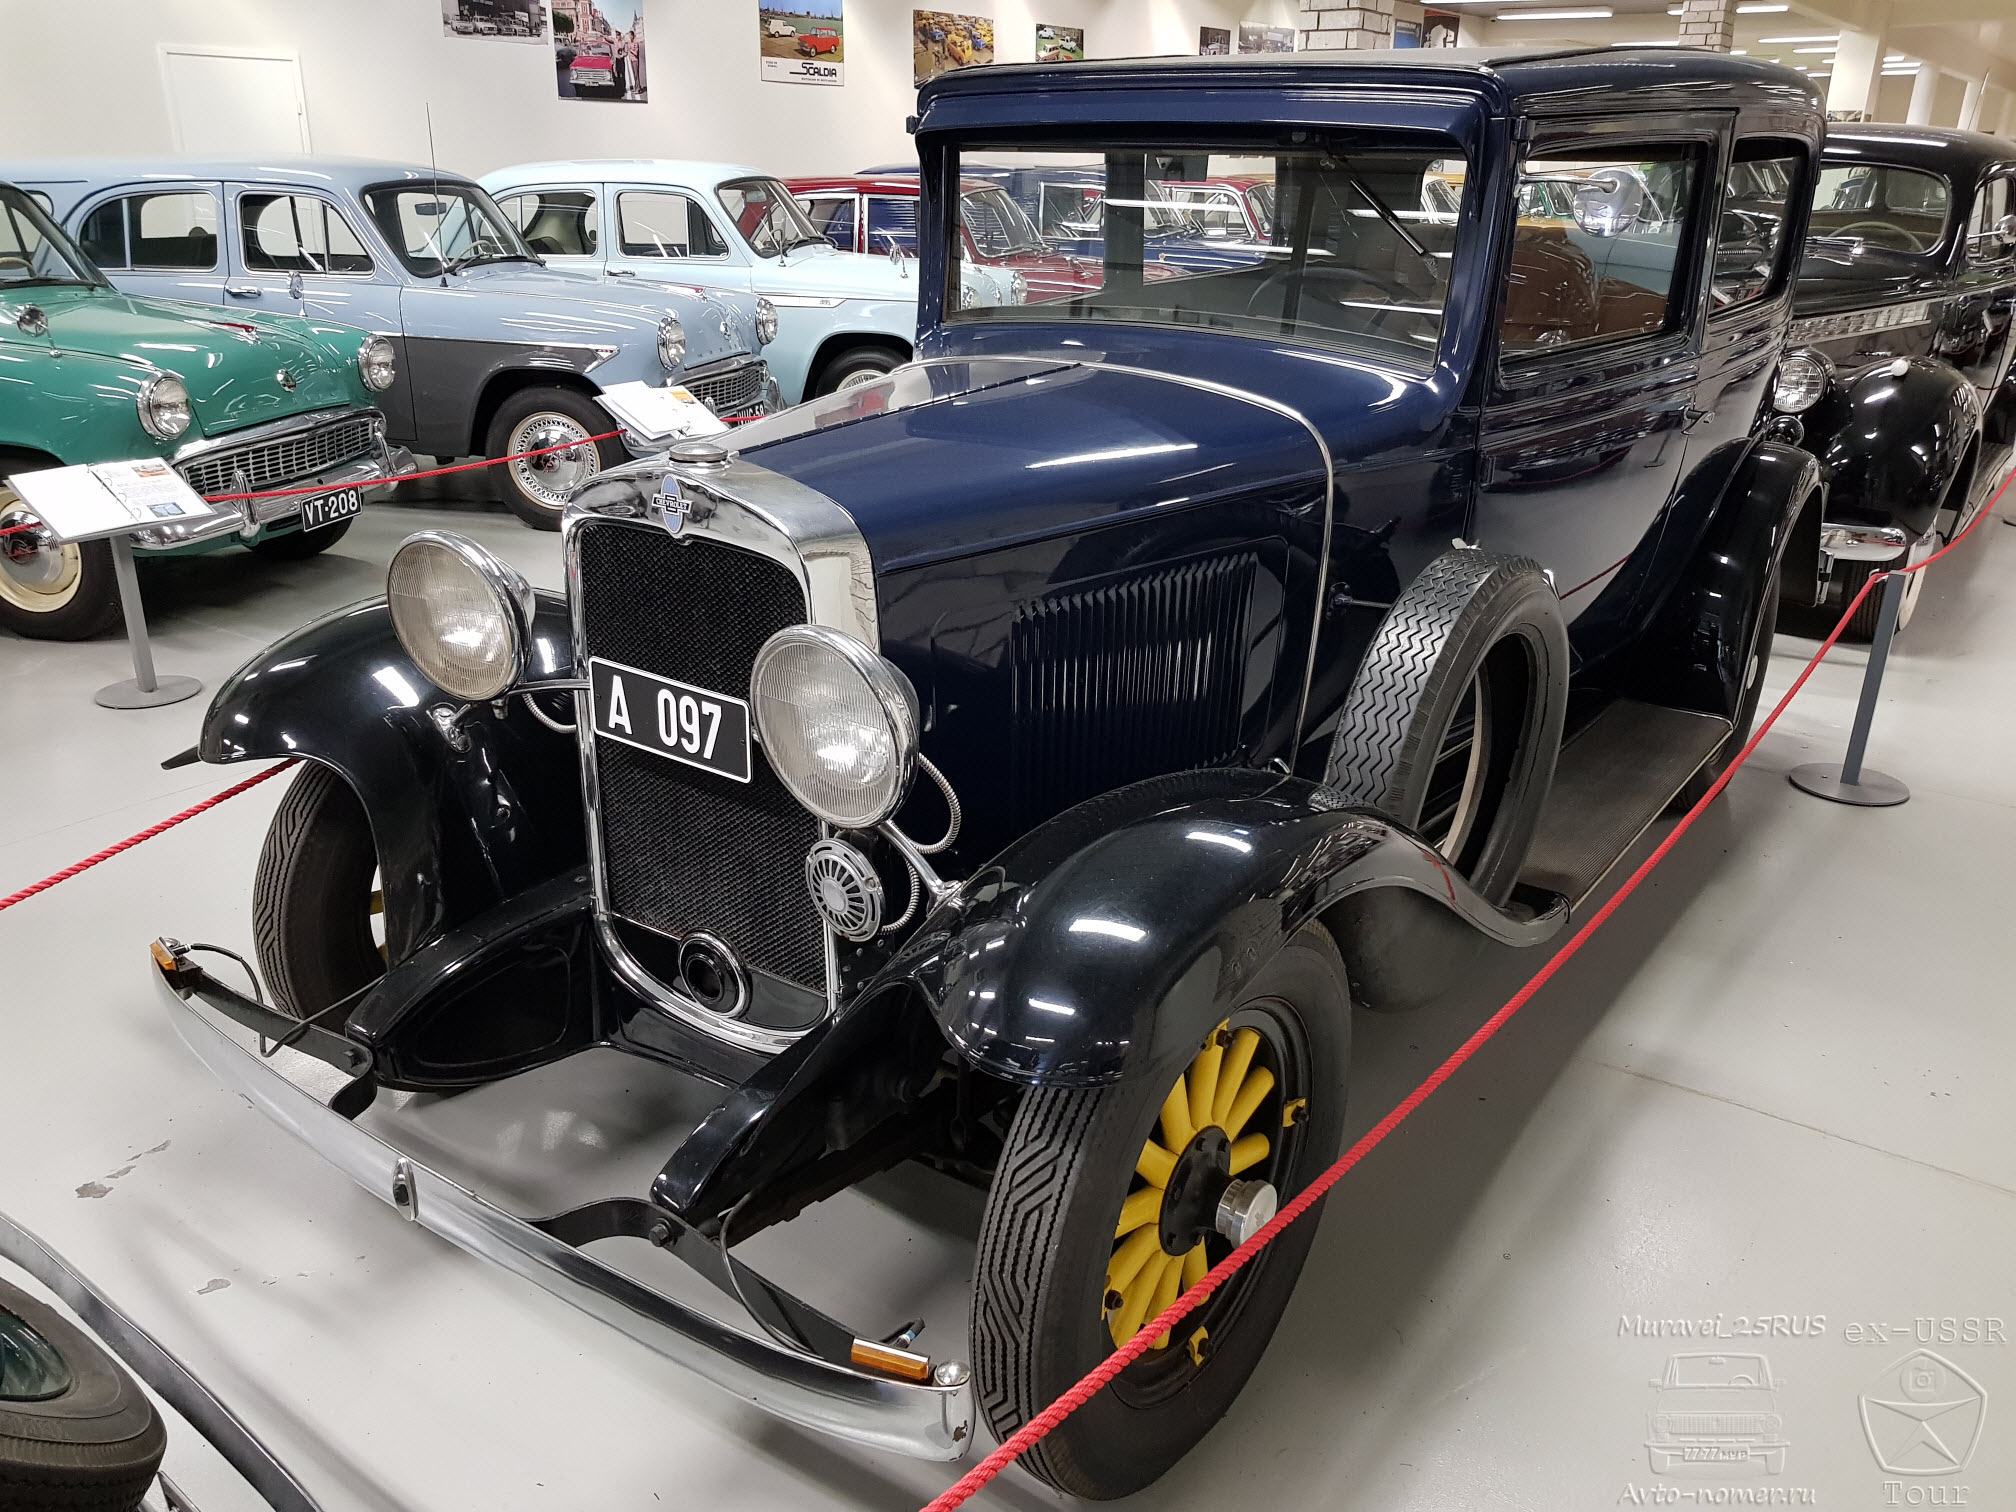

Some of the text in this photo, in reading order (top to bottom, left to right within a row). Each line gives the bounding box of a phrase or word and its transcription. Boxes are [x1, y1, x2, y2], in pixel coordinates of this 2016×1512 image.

[789, 62, 837, 77] SCALDIA
[655, 497, 688, 510] CHEVROLET
[608, 674, 722, 760] A 097
